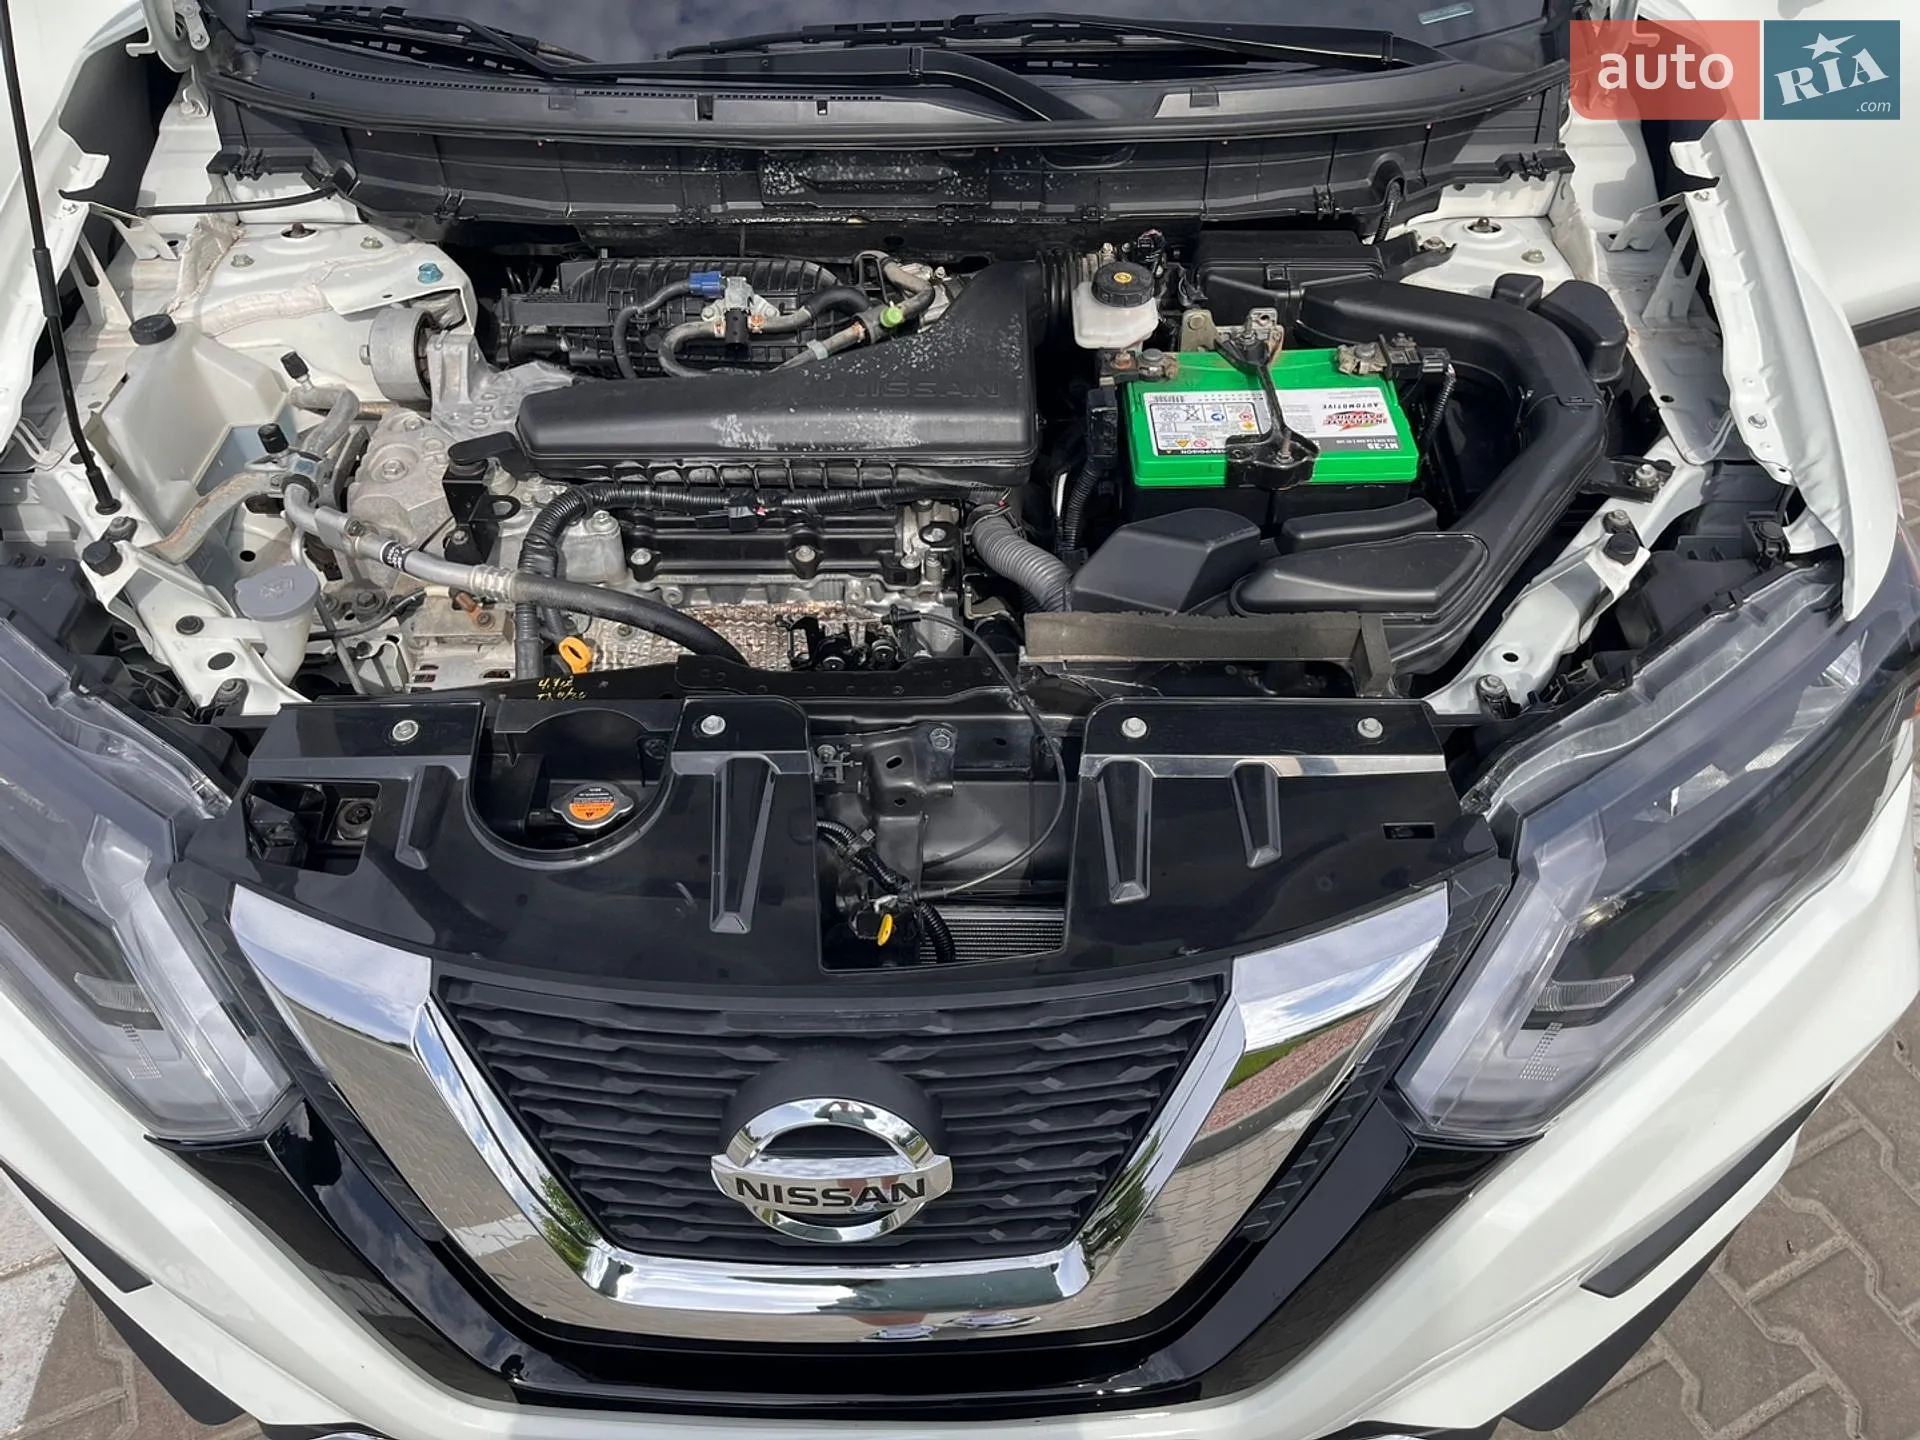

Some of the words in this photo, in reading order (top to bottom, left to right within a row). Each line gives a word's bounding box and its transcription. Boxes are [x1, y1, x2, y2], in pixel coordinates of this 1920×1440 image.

[836, 380, 1001, 399] NISSAN
[1322, 402, 1379, 410] AUTOMOTIVE
[735, 1177, 926, 1207] NISSAN
